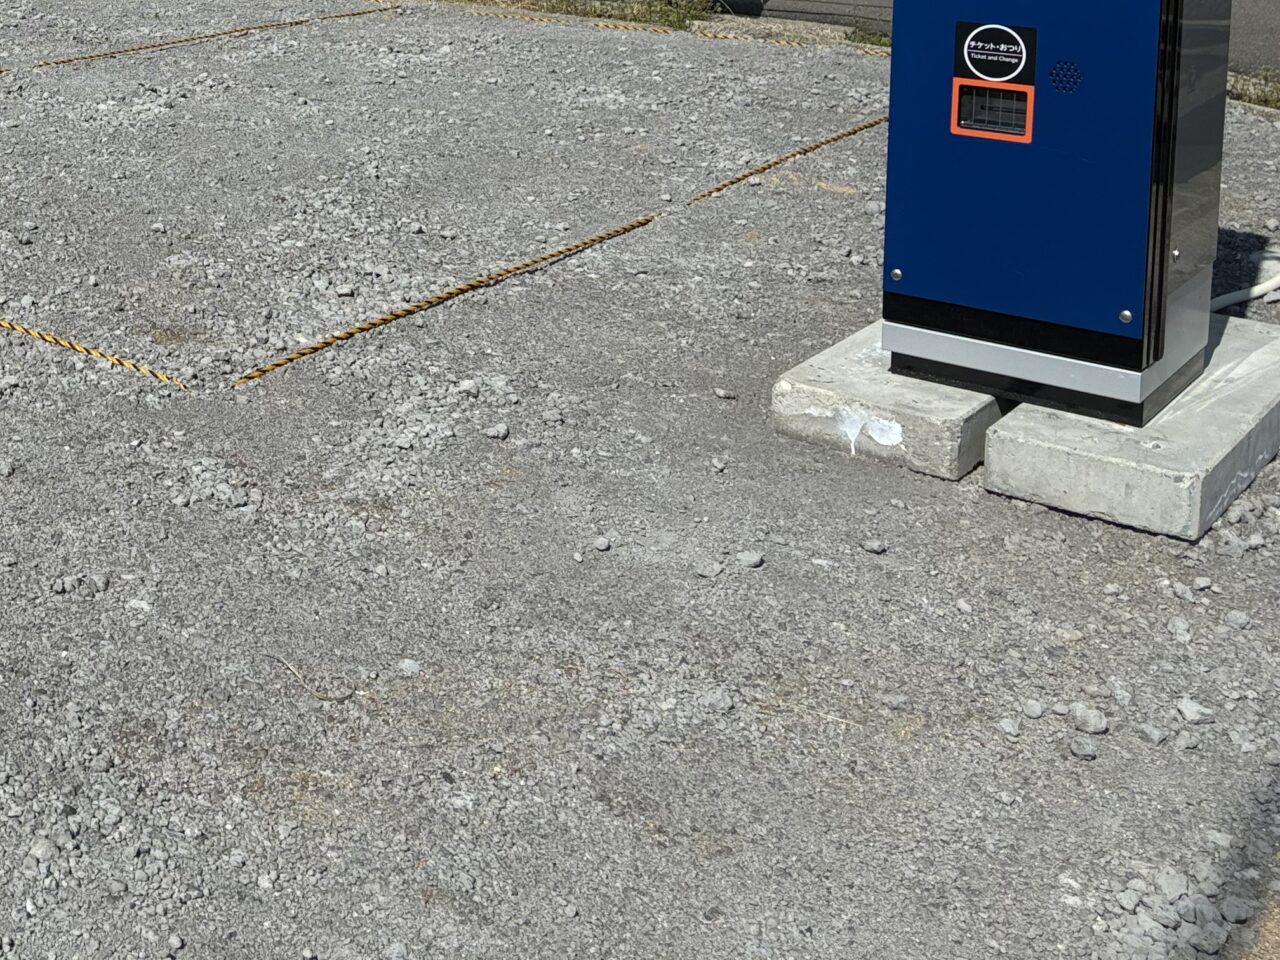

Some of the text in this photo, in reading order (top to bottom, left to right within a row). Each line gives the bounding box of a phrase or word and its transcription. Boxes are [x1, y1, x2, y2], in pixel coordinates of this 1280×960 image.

[969, 40, 1022, 53] チケット・おつり
[998, 56, 1019, 64] Change
